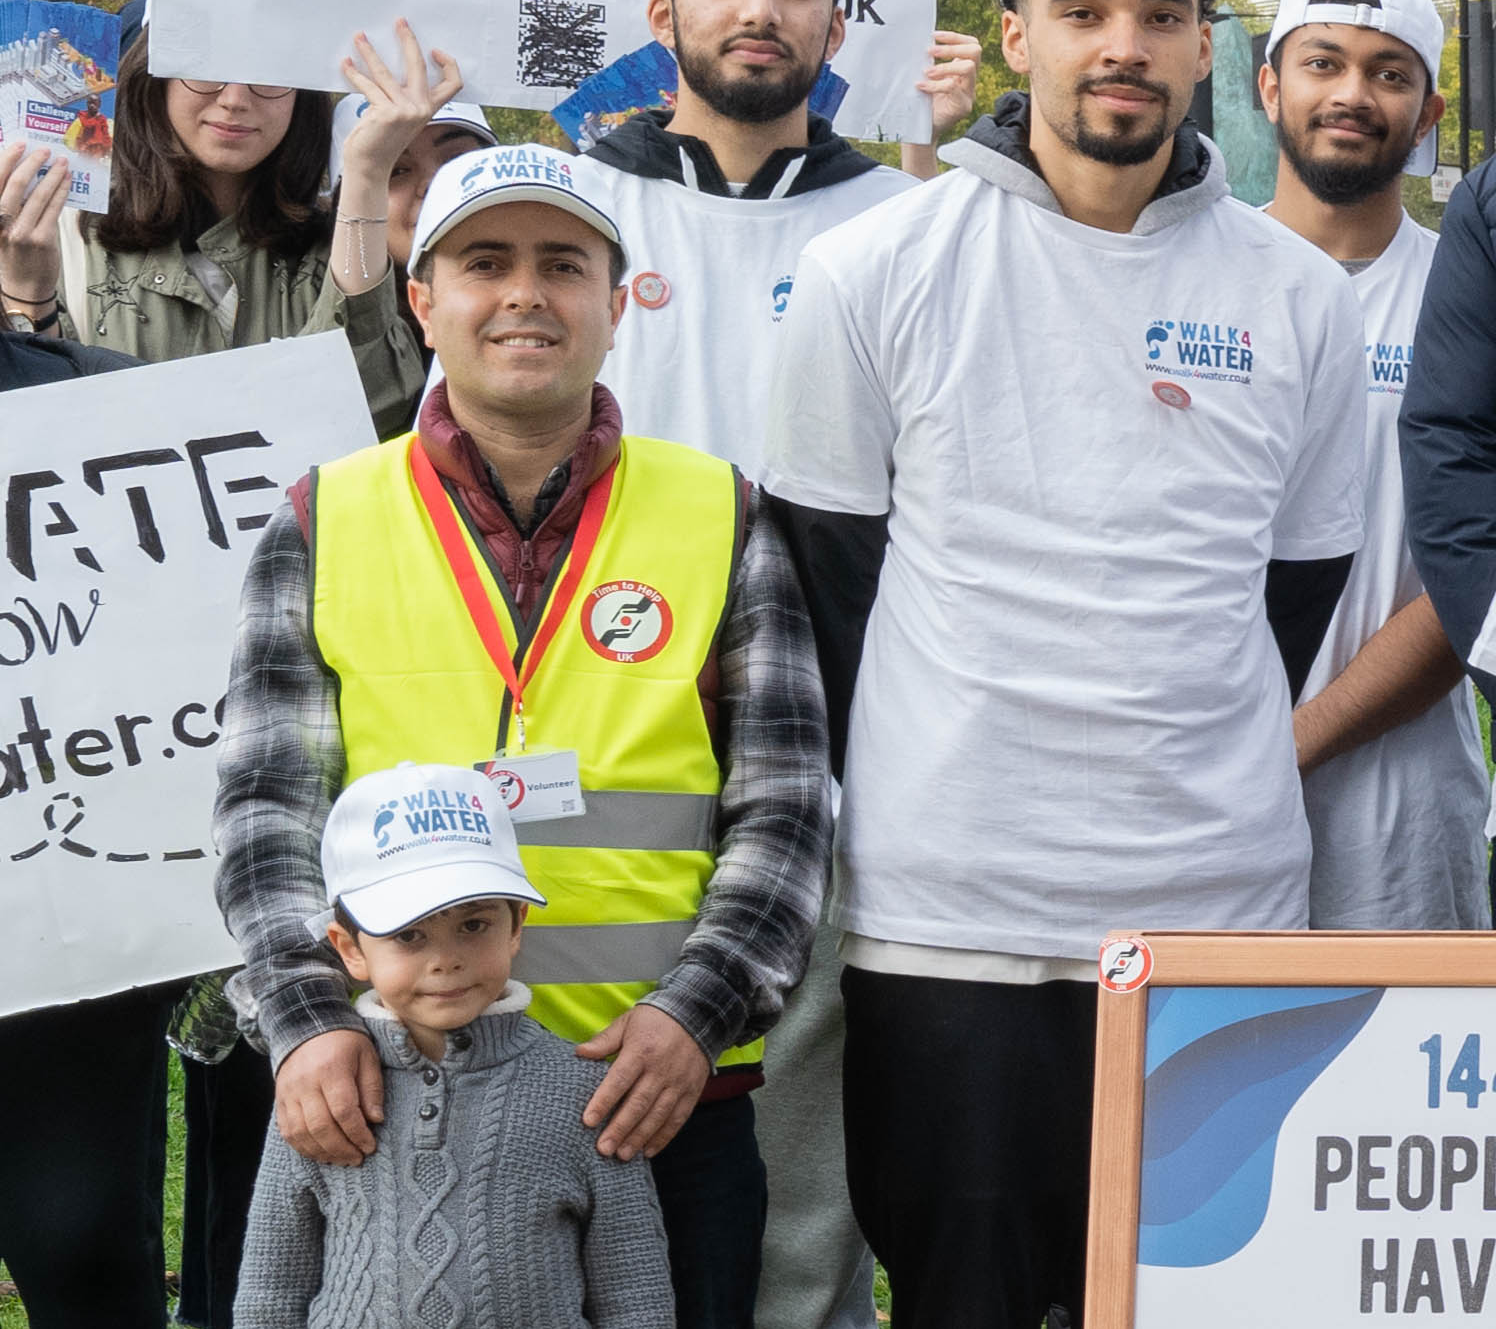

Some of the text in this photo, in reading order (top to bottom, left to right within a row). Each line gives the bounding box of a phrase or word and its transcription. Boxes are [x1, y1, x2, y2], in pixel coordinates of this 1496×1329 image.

[28, 101, 76, 120] Challenge
[493, 150, 572, 176] WALK4
[491, 162, 574, 190] WATER
[1179, 320, 1252, 349] WALK4
[1177, 341, 1254, 373] WATER
[591, 580, 663, 605] Time to Help
[616, 652, 635, 662] UK
[526, 780, 576, 791] Volunteer
[403, 789, 484, 812] WALK4
[404, 808, 492, 836] WATER
